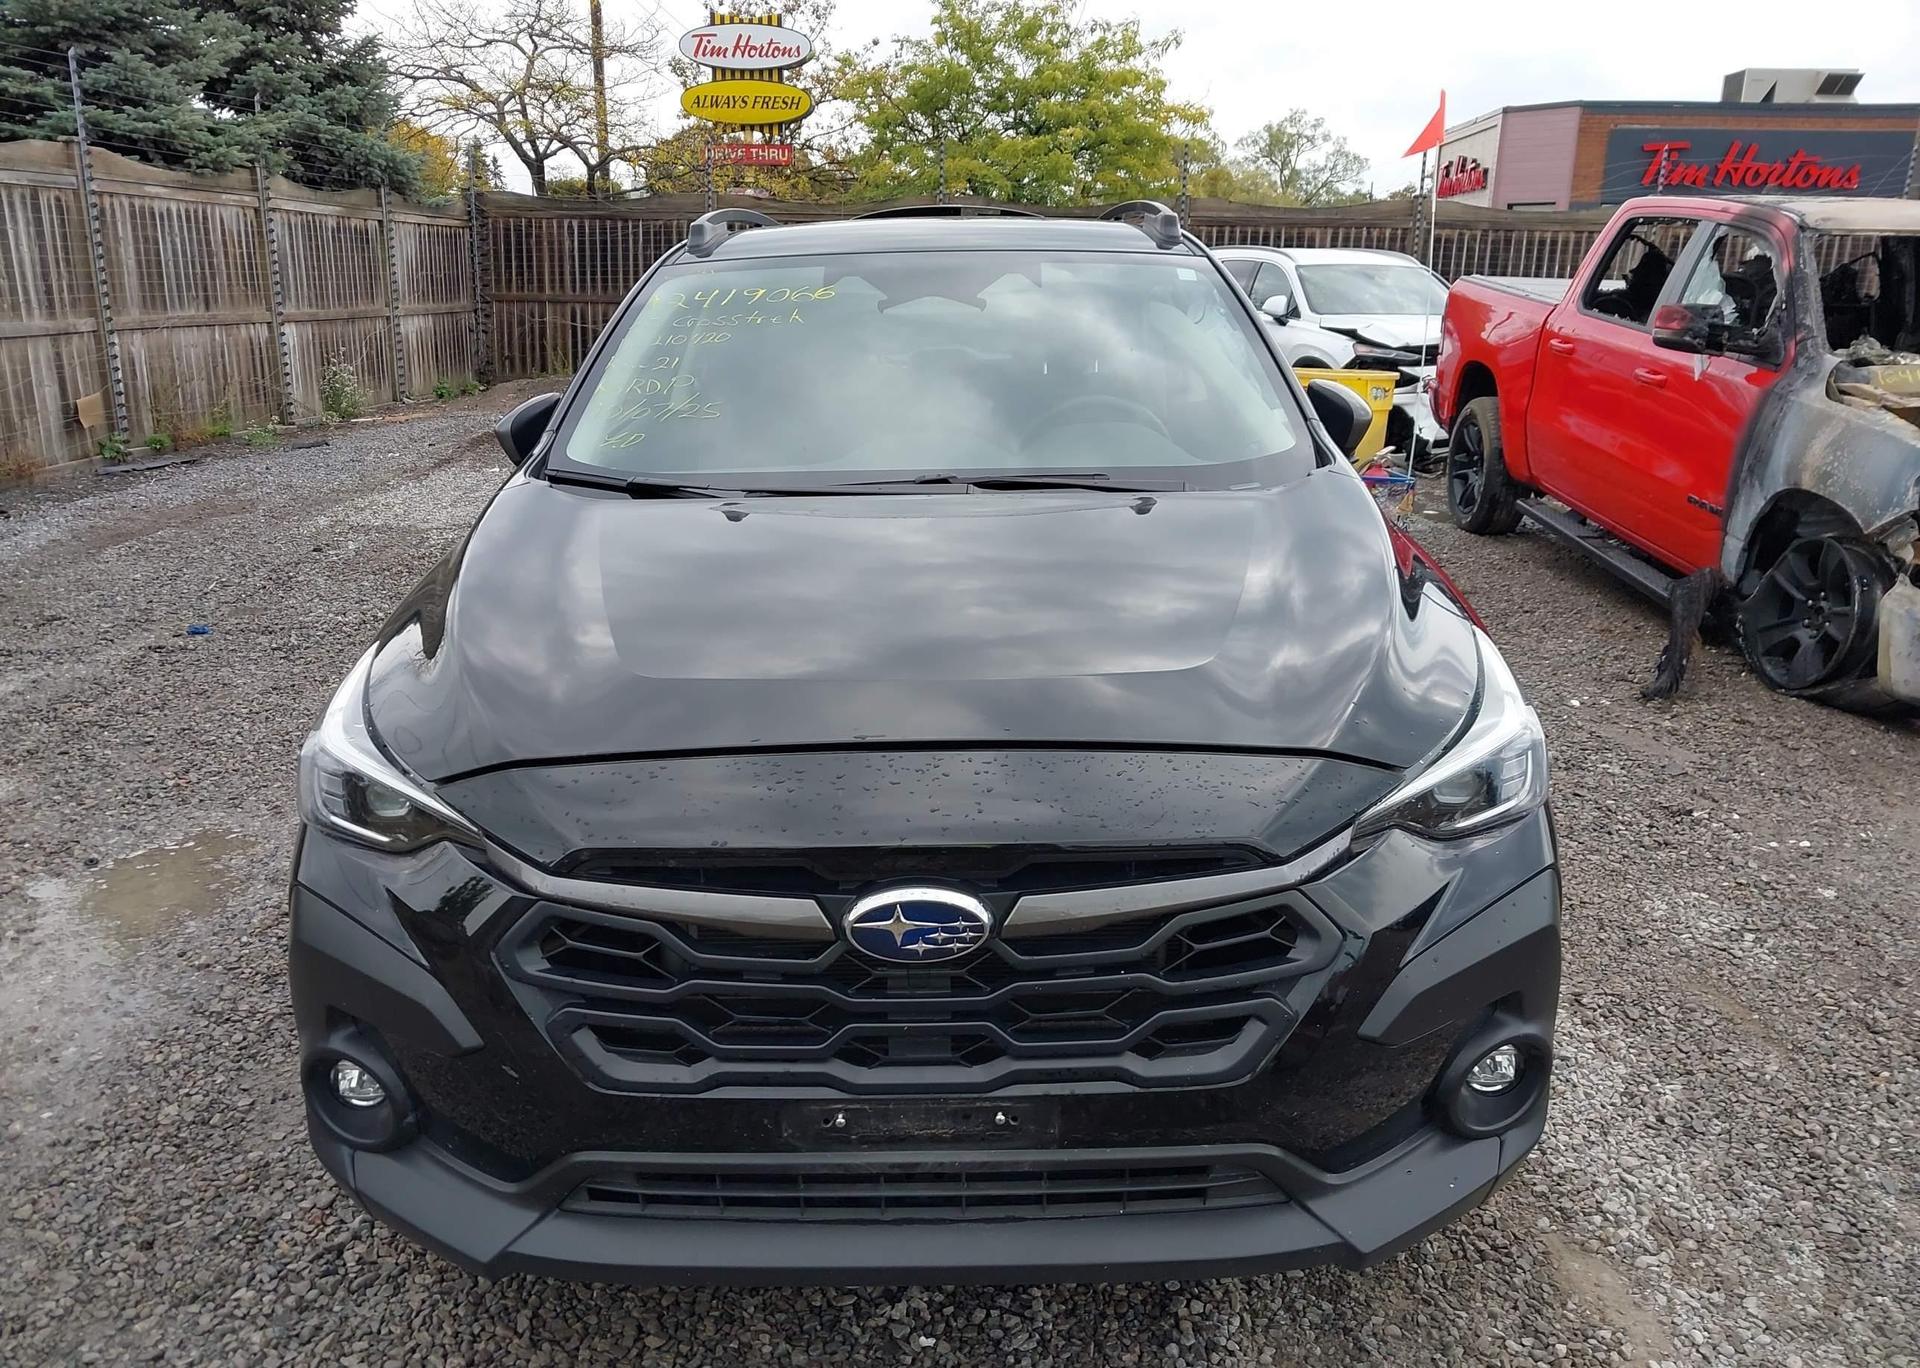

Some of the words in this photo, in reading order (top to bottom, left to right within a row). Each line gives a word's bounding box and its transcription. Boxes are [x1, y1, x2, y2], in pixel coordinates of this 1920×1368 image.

[691, 33, 728, 59] Tim
[731, 33, 801, 59] Hortons
[690, 95, 748, 109] ALWAYS
[752, 96, 802, 110] FRESH
[750, 147, 788, 161] THRU
[1641, 140, 1710, 187] Tim
[1713, 139, 1861, 189] Hortons
